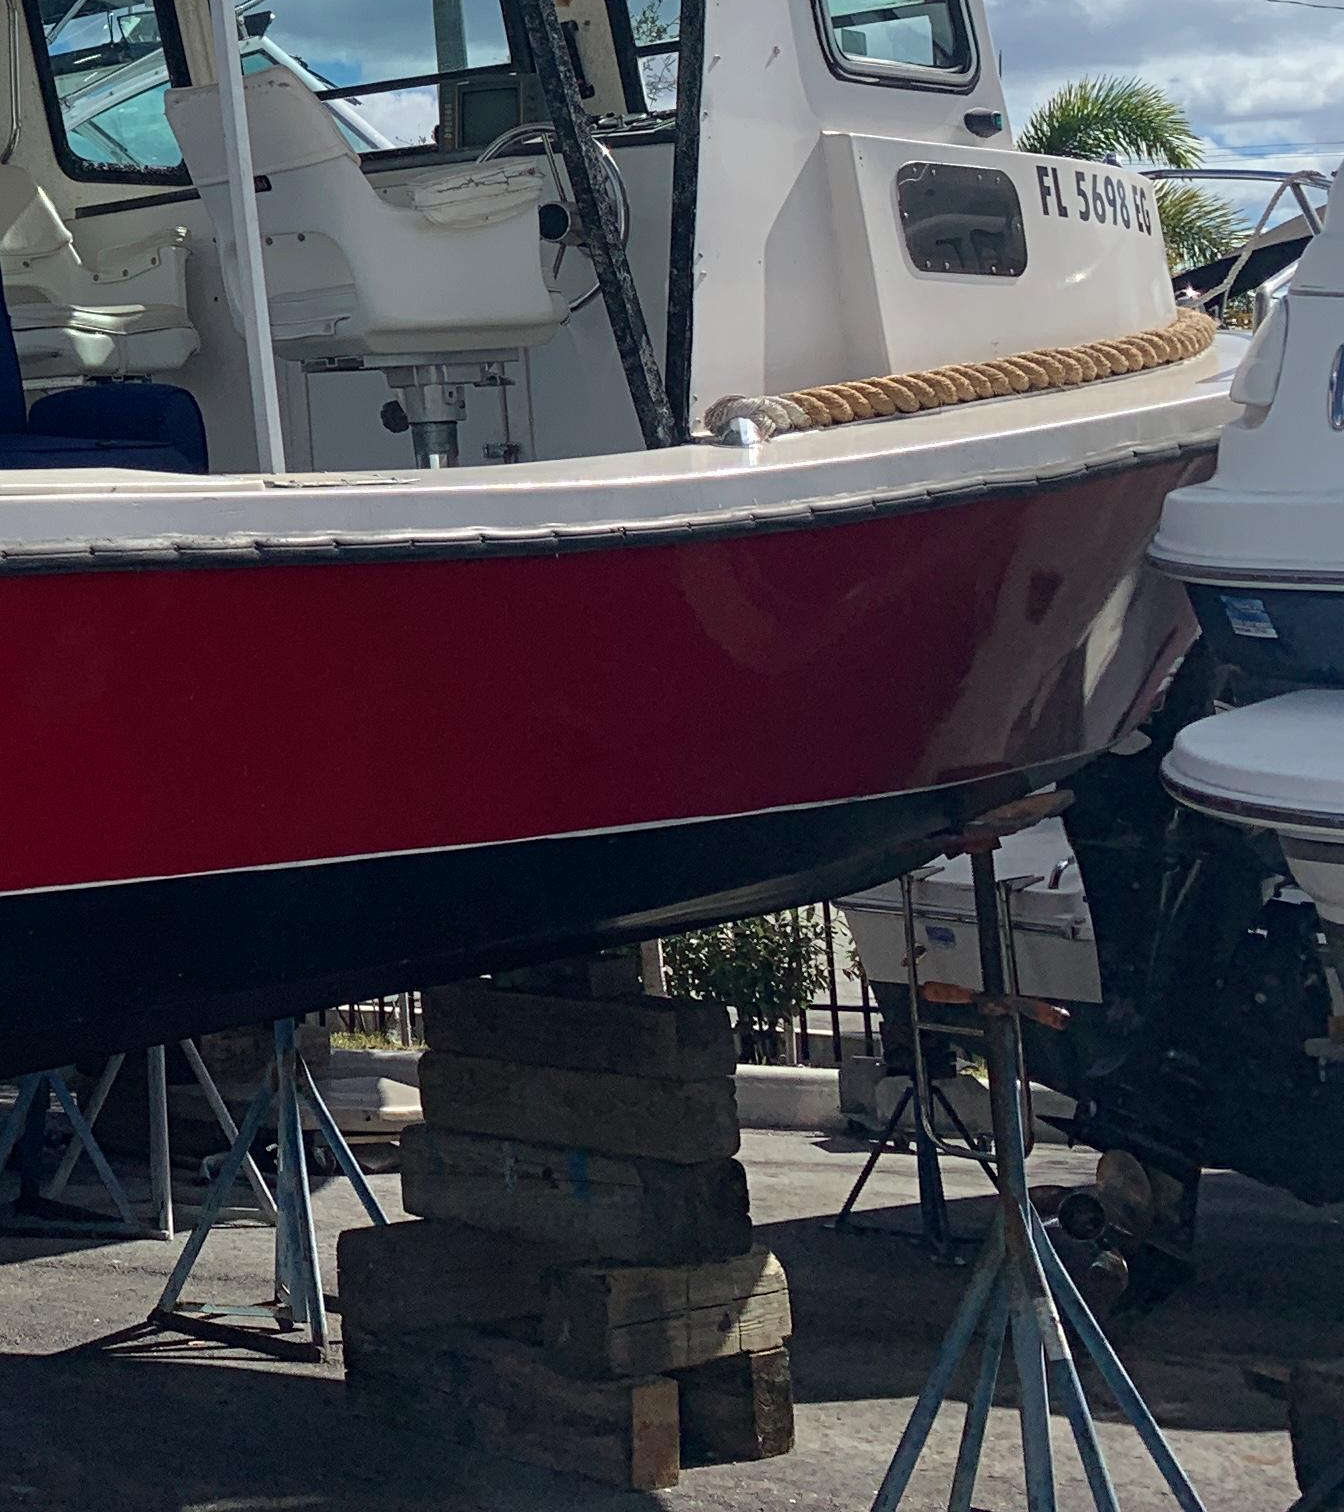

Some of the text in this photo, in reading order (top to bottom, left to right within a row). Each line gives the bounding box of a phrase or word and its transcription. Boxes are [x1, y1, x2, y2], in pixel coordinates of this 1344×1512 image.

[1035, 165, 1152, 236] FL 5698 EG
